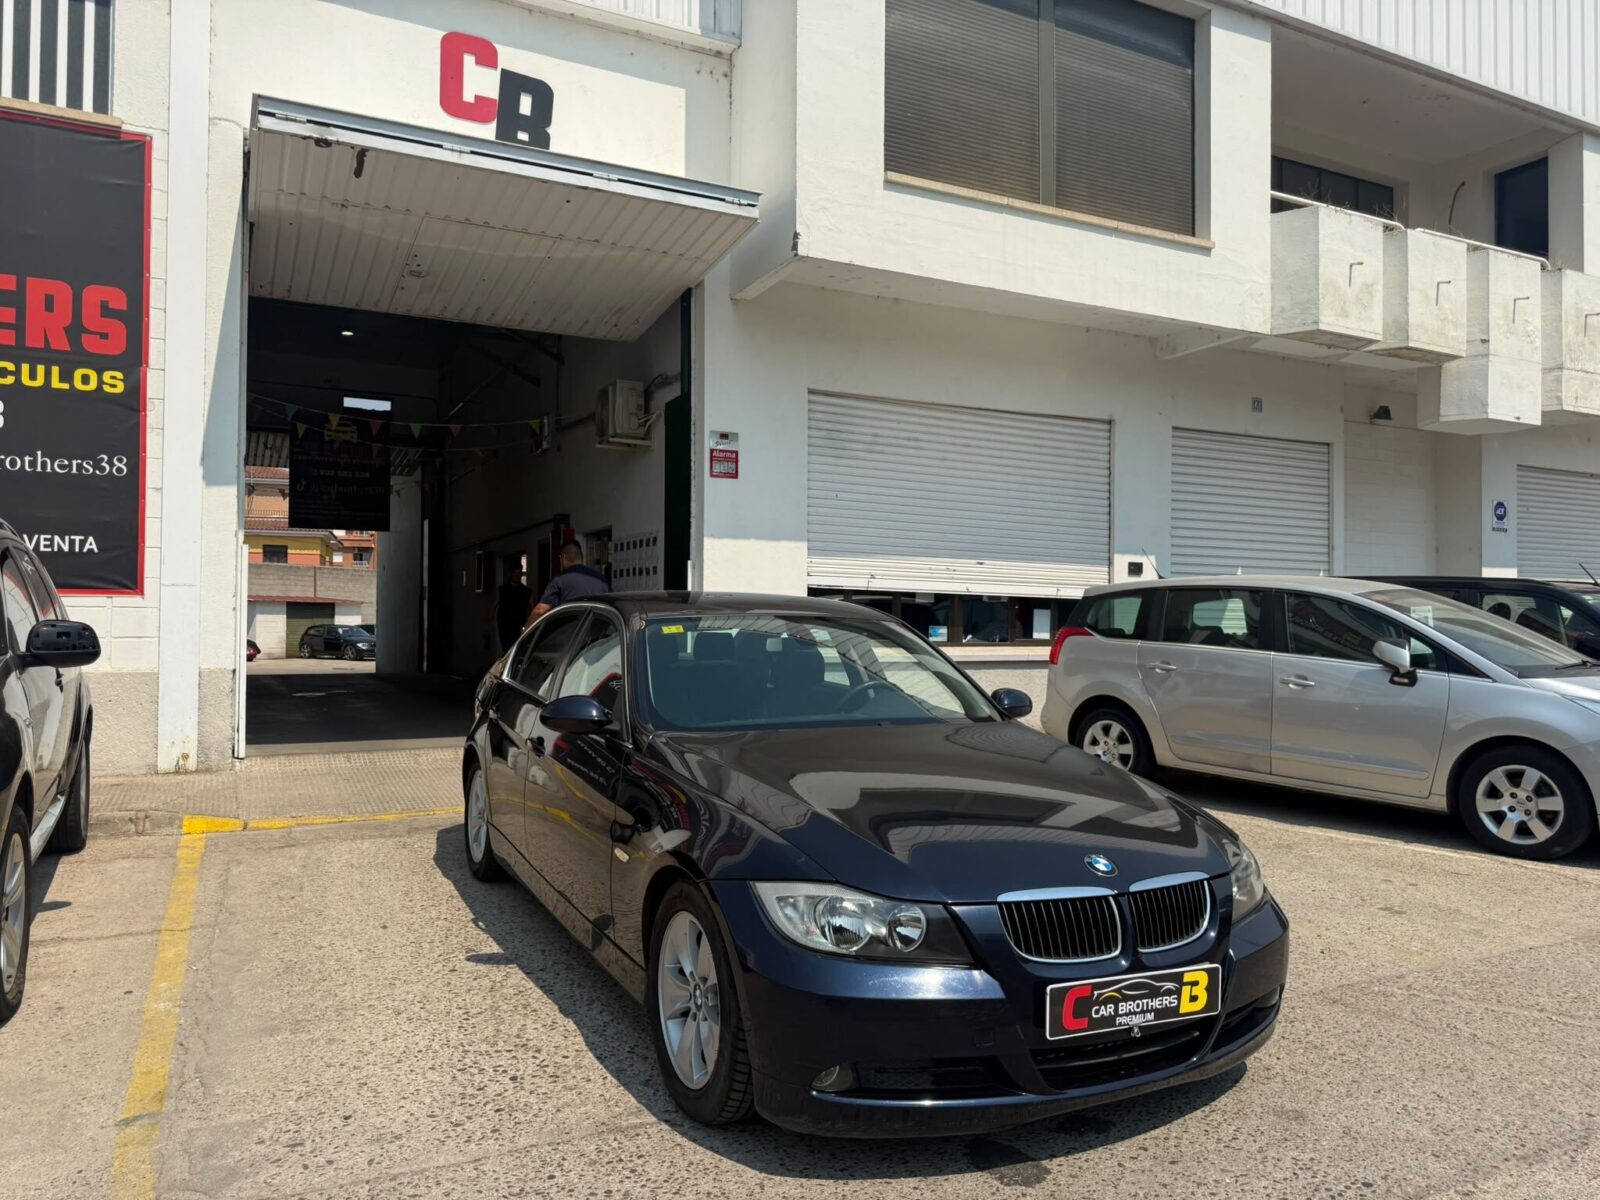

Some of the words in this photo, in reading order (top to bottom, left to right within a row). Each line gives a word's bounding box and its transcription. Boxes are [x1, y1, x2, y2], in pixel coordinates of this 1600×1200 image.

[712, 450, 736, 458] Alarma
[23, 533, 99, 553] VENTA
[1092, 1004, 1114, 1018] CAR
[1118, 995, 1178, 1015] BROTHERS
[1116, 1011, 1155, 1026] PREMIUM
